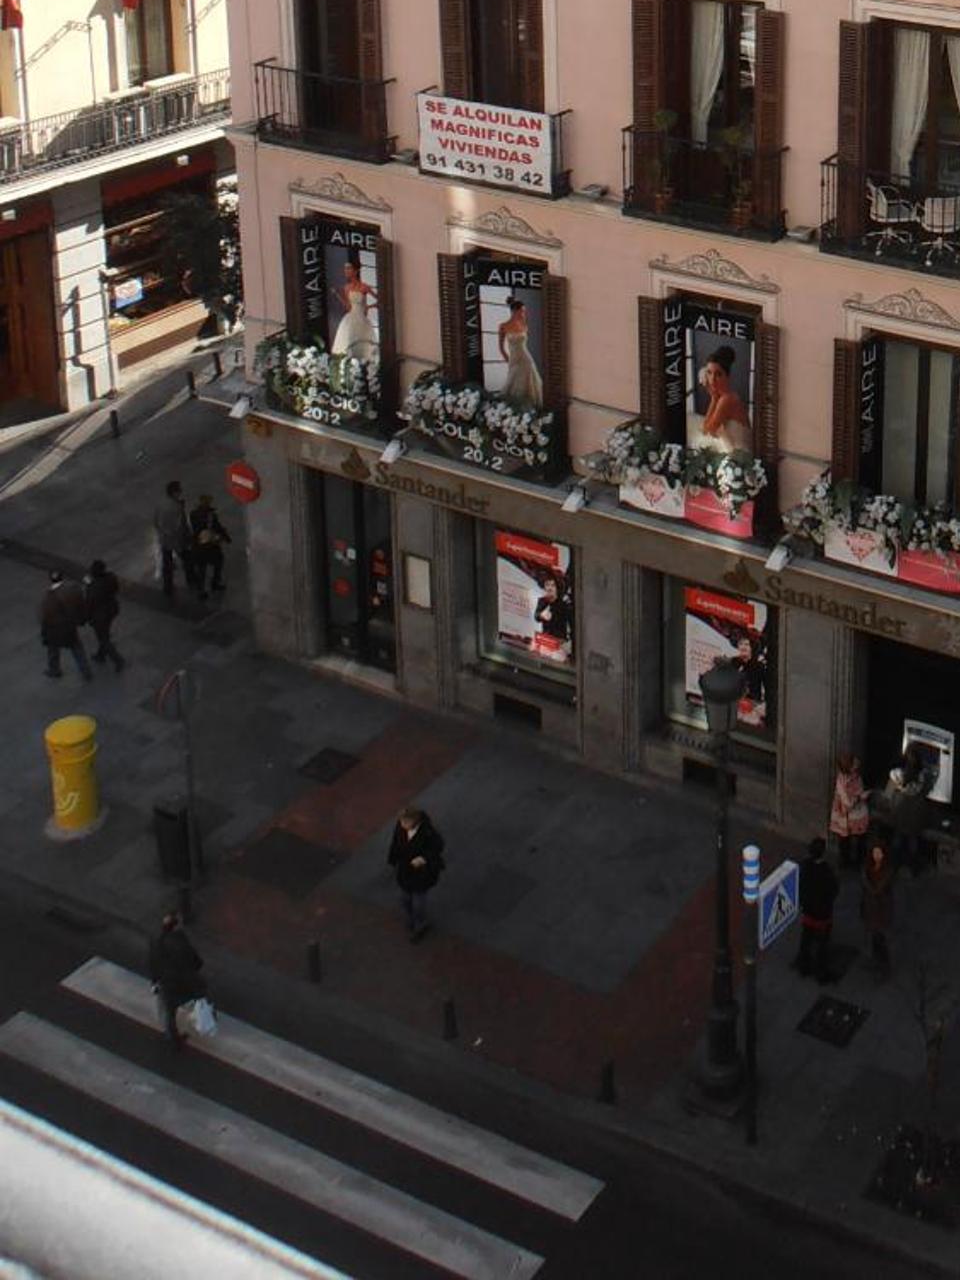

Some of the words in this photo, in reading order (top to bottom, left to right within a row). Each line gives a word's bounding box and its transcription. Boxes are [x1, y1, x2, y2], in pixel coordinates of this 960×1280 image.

[425, 100, 448, 115] SE
[452, 103, 542, 131] ALQUILAN
[430, 119, 540, 148] MAGNIFICAS
[438, 137, 533, 164] VIVIENDAS
[426, 153, 447, 168] 91
[454, 158, 486, 175] 431
[493, 165, 515, 181] 38
[521, 170, 543, 187] 42
[330, 229, 377, 250] AIRE
[487, 268, 543, 288] AIRE
[664, 303, 682, 376] AIRE
[694, 314, 748, 340] AIRE
[303, 405, 341, 426] 2012
[375, 463, 491, 513] Santander
[764, 574, 908, 634] Santander
